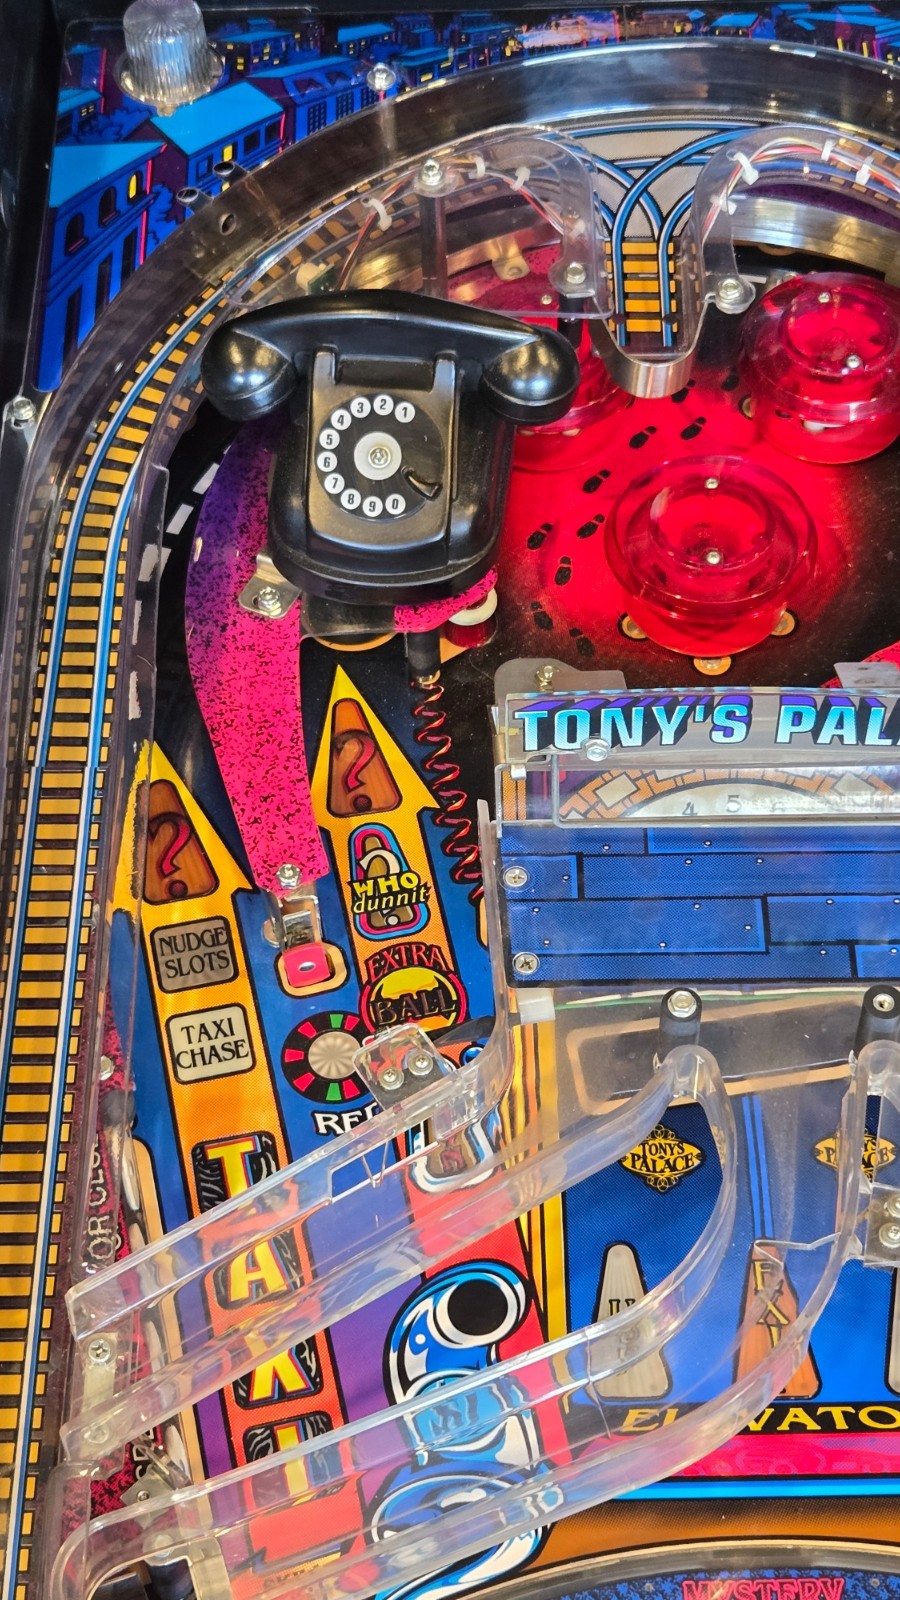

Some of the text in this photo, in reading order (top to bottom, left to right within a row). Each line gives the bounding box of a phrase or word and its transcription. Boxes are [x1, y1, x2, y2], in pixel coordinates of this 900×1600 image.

[323, 398, 408, 512] 1 2 3 4 5 6 7 8 9 0
[513, 695, 900, 751] TONY'S PAL
[682, 794, 741, 817] 4 5
[353, 872, 419, 897] WHO
[353, 886, 427, 914] dunnit
[159, 927, 228, 957] NUDGE
[165, 950, 230, 979] SLOTS
[367, 943, 449, 982] EXTRA
[374, 989, 456, 1025] BALL
[181, 1017, 236, 1045] TAXI
[176, 1039, 249, 1070] CHASE
[630, 1152, 695, 1174] PALACE
[640, 1141, 685, 1157] TONYS
